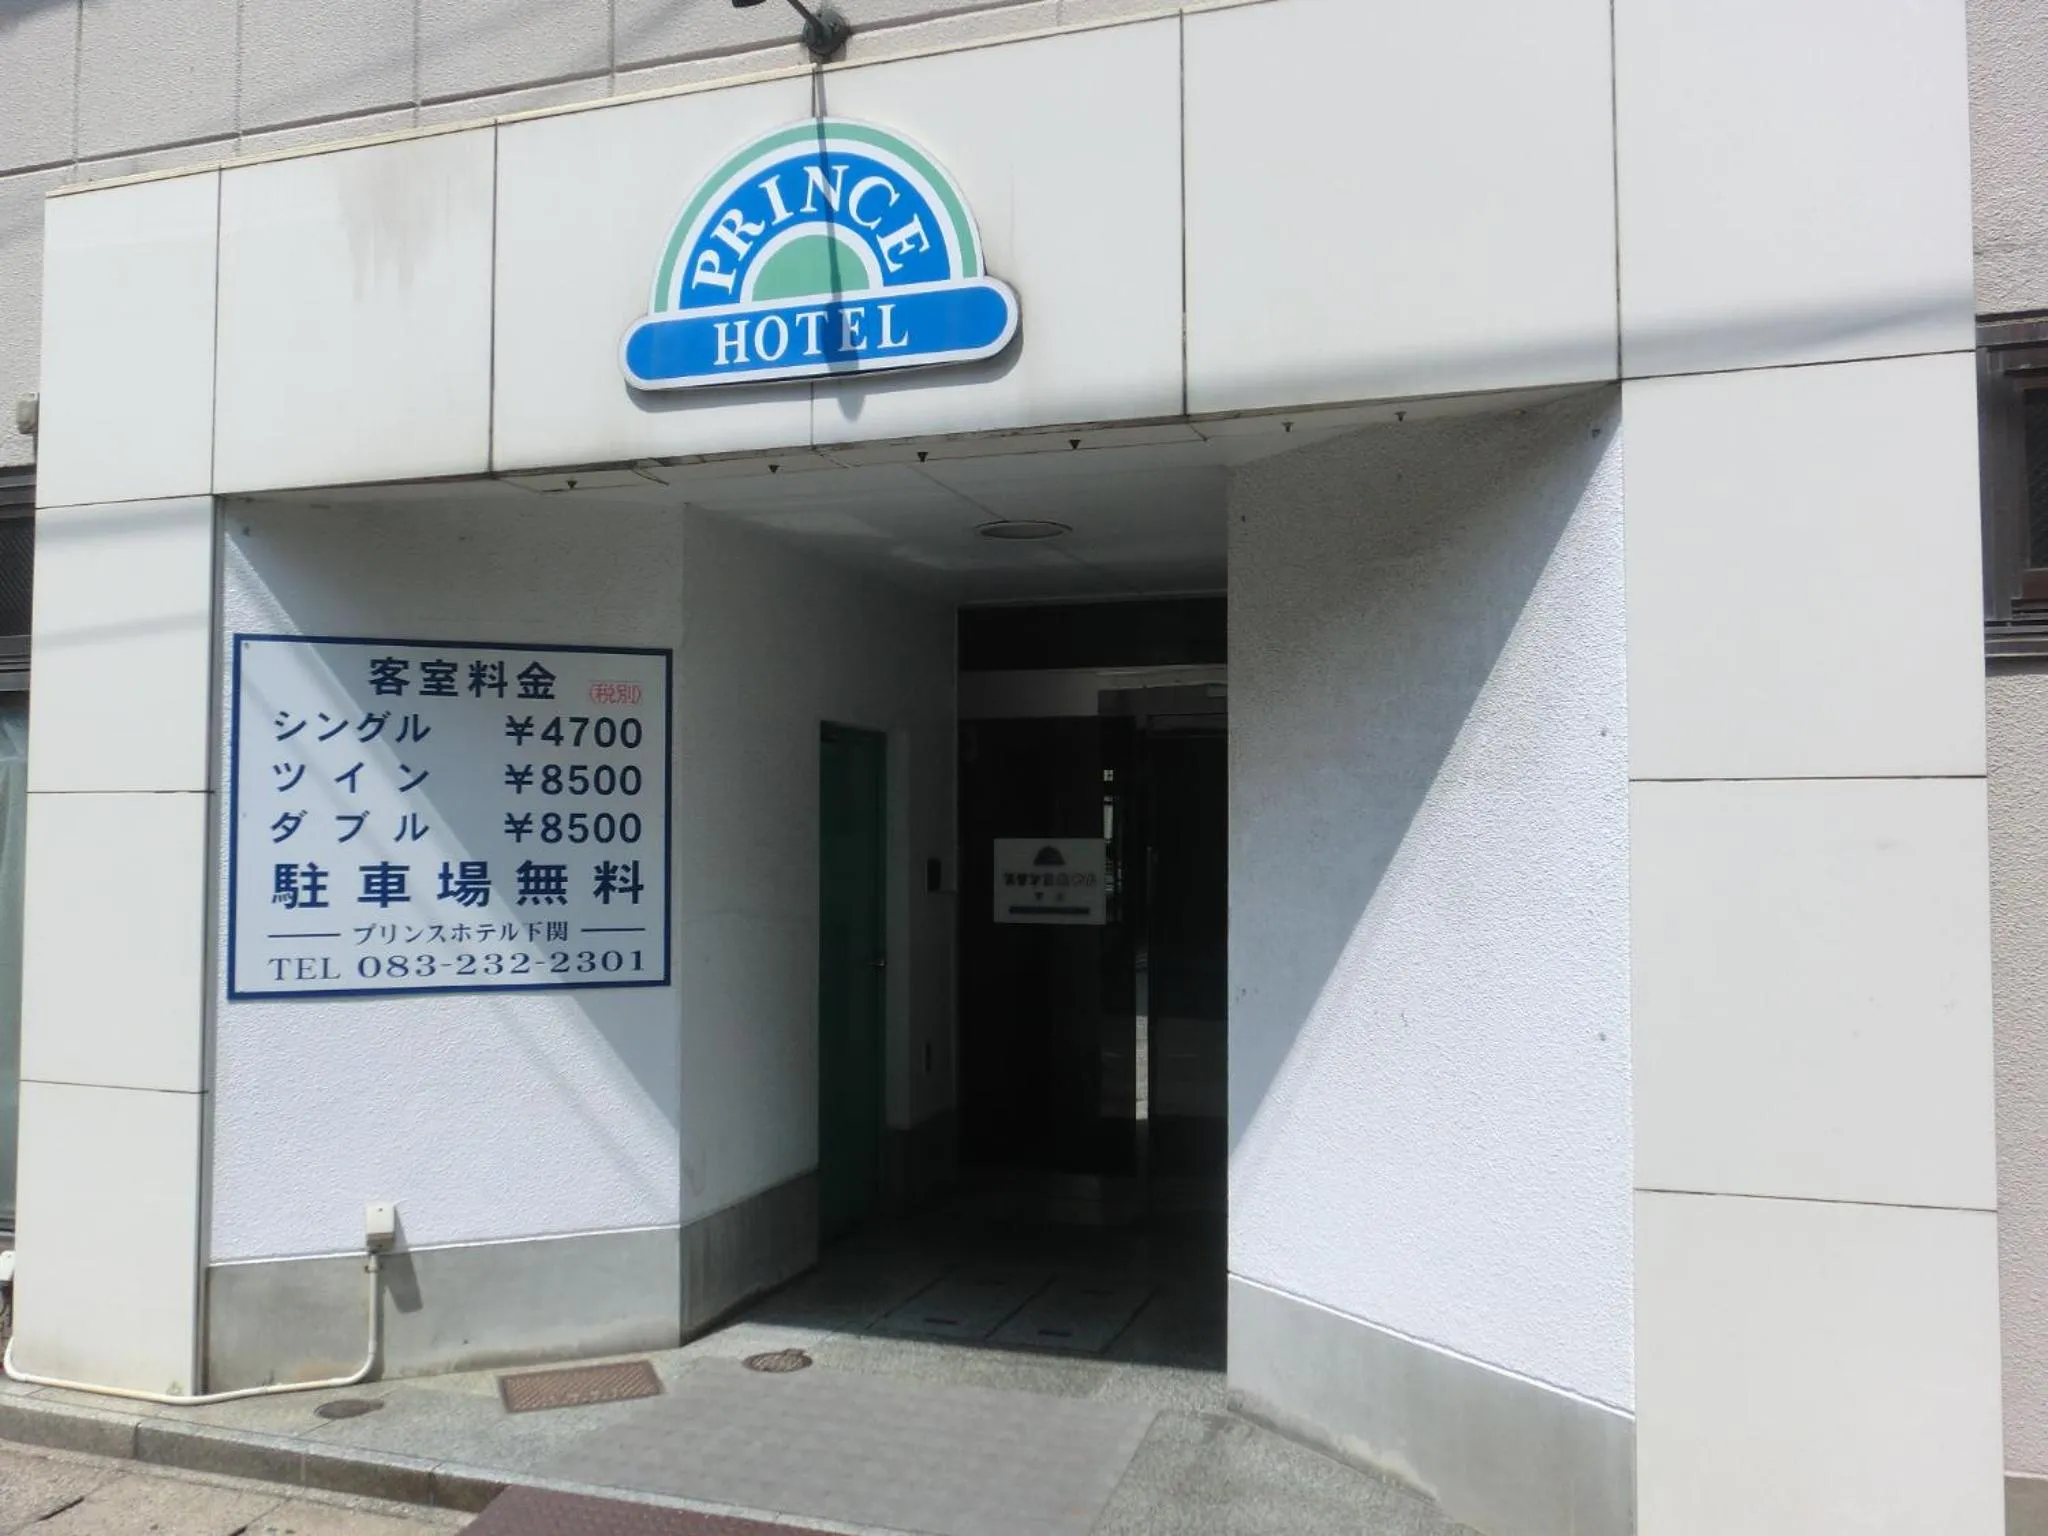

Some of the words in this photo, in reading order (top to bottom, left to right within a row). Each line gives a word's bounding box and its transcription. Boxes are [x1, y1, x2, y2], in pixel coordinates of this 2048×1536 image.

[692, 165, 931, 295] PRINCE
[713, 304, 909, 367] HOTEL
[368, 657, 557, 700] 客室料金
[273, 710, 432, 744] シングル
[504, 715, 643, 749] ¥4700
[272, 761, 430, 794] ツイン
[503, 763, 643, 797] ¥8500
[269, 809, 430, 845] ダブル
[503, 811, 643, 845] ¥8500
[270, 860, 645, 911] 駐車場無料
[352, 920, 569, 946] プリンスホテル下関
[267, 956, 342, 981] TEL
[357, 950, 646, 979] 083-232-2301
